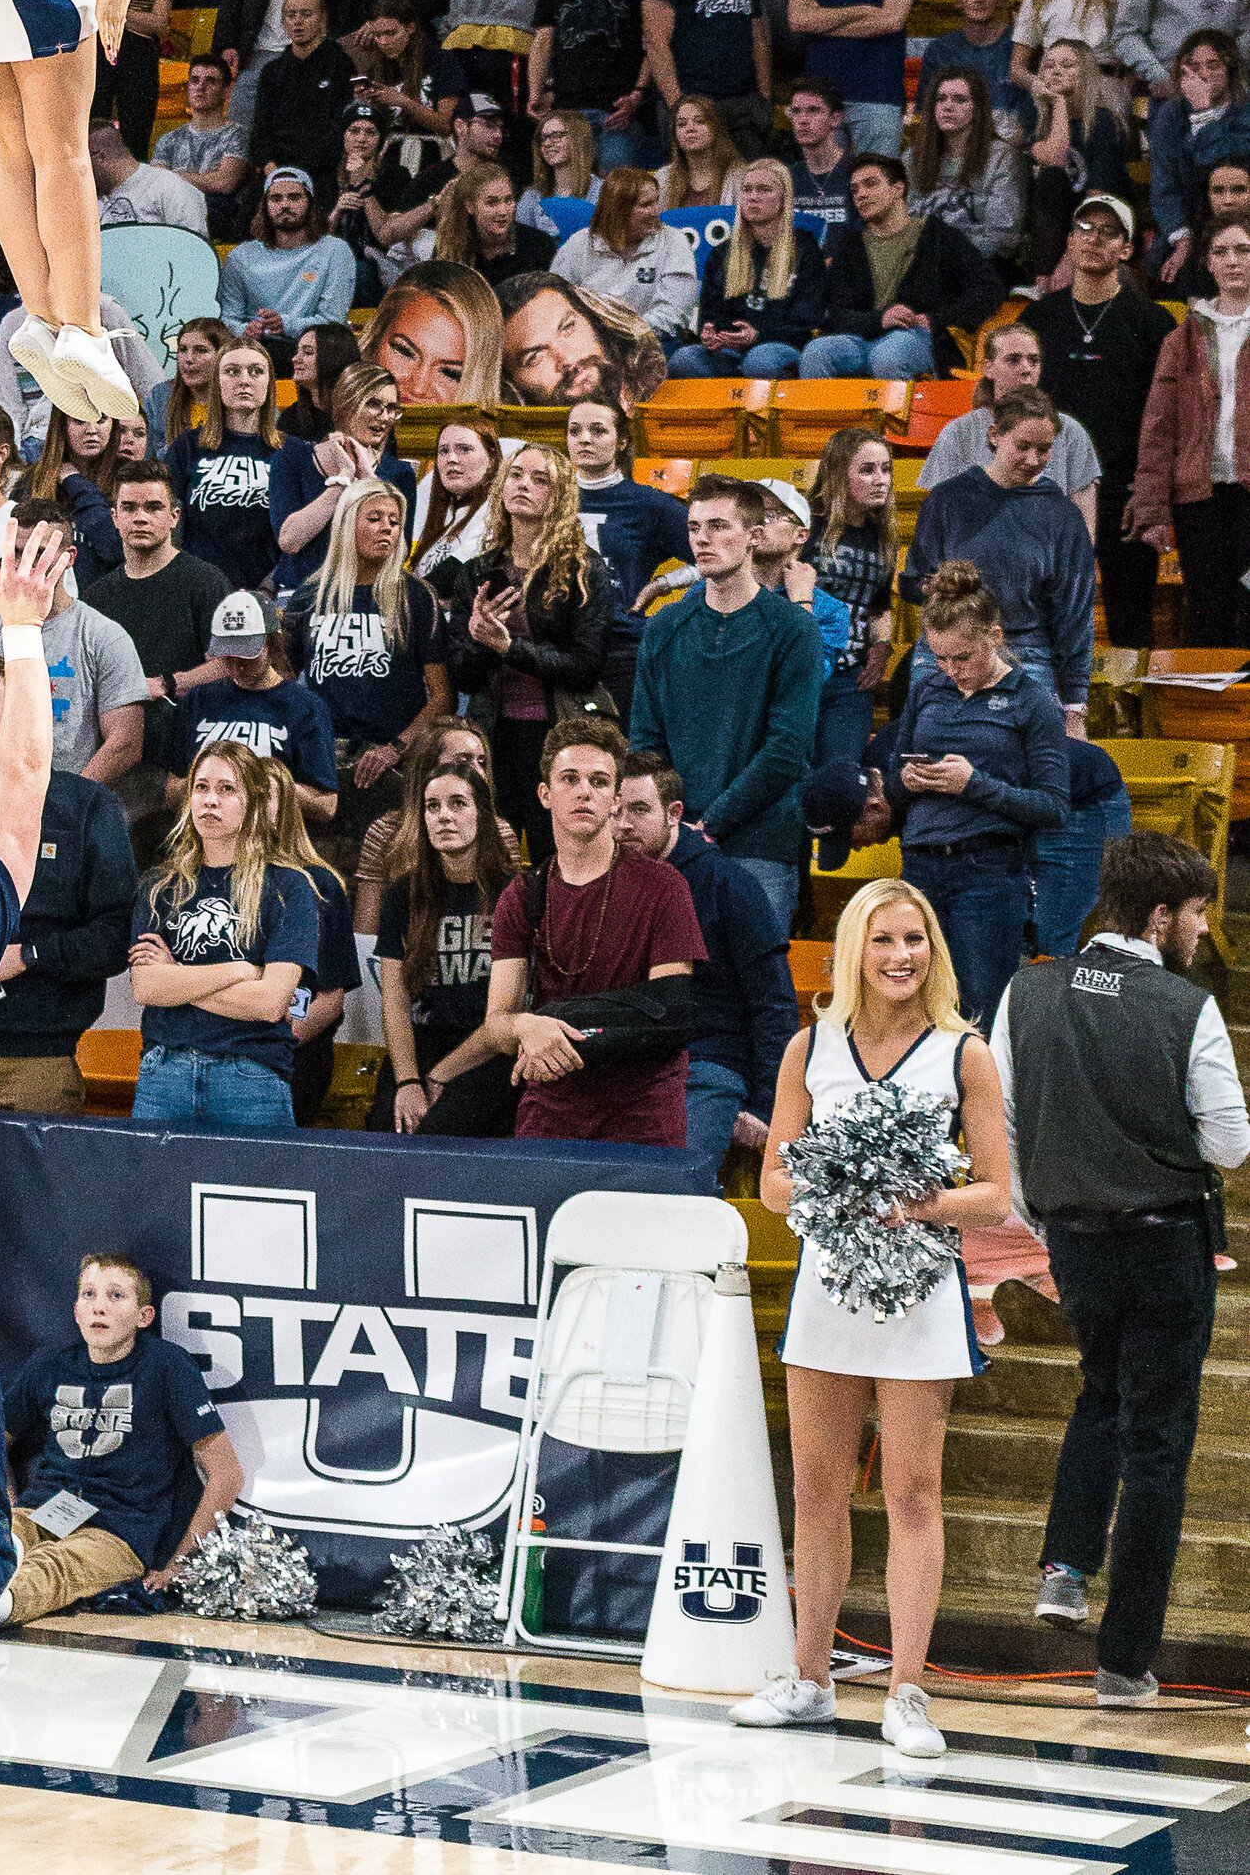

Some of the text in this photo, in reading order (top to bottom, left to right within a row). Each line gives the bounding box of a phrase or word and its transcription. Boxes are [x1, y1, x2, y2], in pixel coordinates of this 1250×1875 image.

[199, 455, 271, 489] USU
[310, 613, 387, 652] USU
[309, 643, 392, 685] AGGIES
[1074, 966, 1124, 985] EVENT
[161, 1291, 539, 1423] STATE
[674, 1566, 768, 1598] STATE
